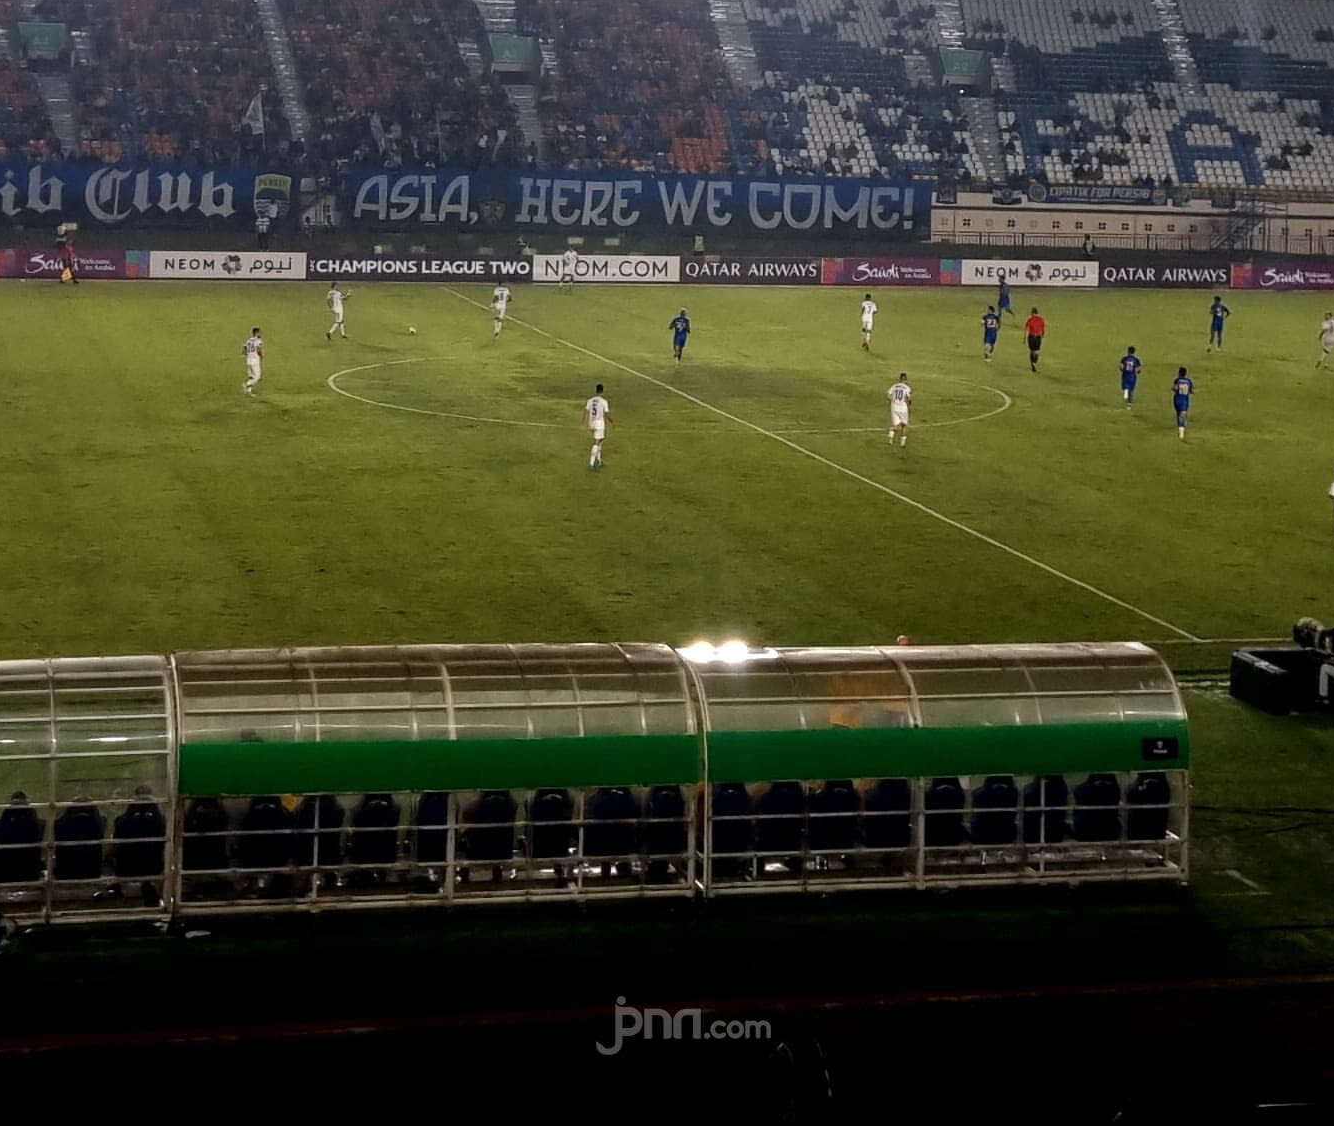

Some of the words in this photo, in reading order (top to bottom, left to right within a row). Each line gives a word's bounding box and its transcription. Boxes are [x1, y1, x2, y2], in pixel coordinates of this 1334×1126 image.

[84, 166, 237, 224] Club
[354, 174, 479, 225] ASIA,
[515, 177, 642, 227] HERE
[657, 180, 732, 227] WE
[749, 181, 915, 230] COME!
[164, 258, 215, 270] NEOM
[316, 260, 417, 274] CHAMPIONS
[421, 261, 485, 275] LEAGUE
[489, 261, 529, 275] TWO
[545, 260, 668, 278] NOM.COM
[685, 261, 740, 278] QATAR
[748, 262, 818, 277] AIRWAYS
[852, 263, 900, 281] Saudi
[974, 267, 1019, 279] NEOM
[1103, 266, 1156, 283] QATAR
[1162, 267, 1227, 283] AIRWAYS
